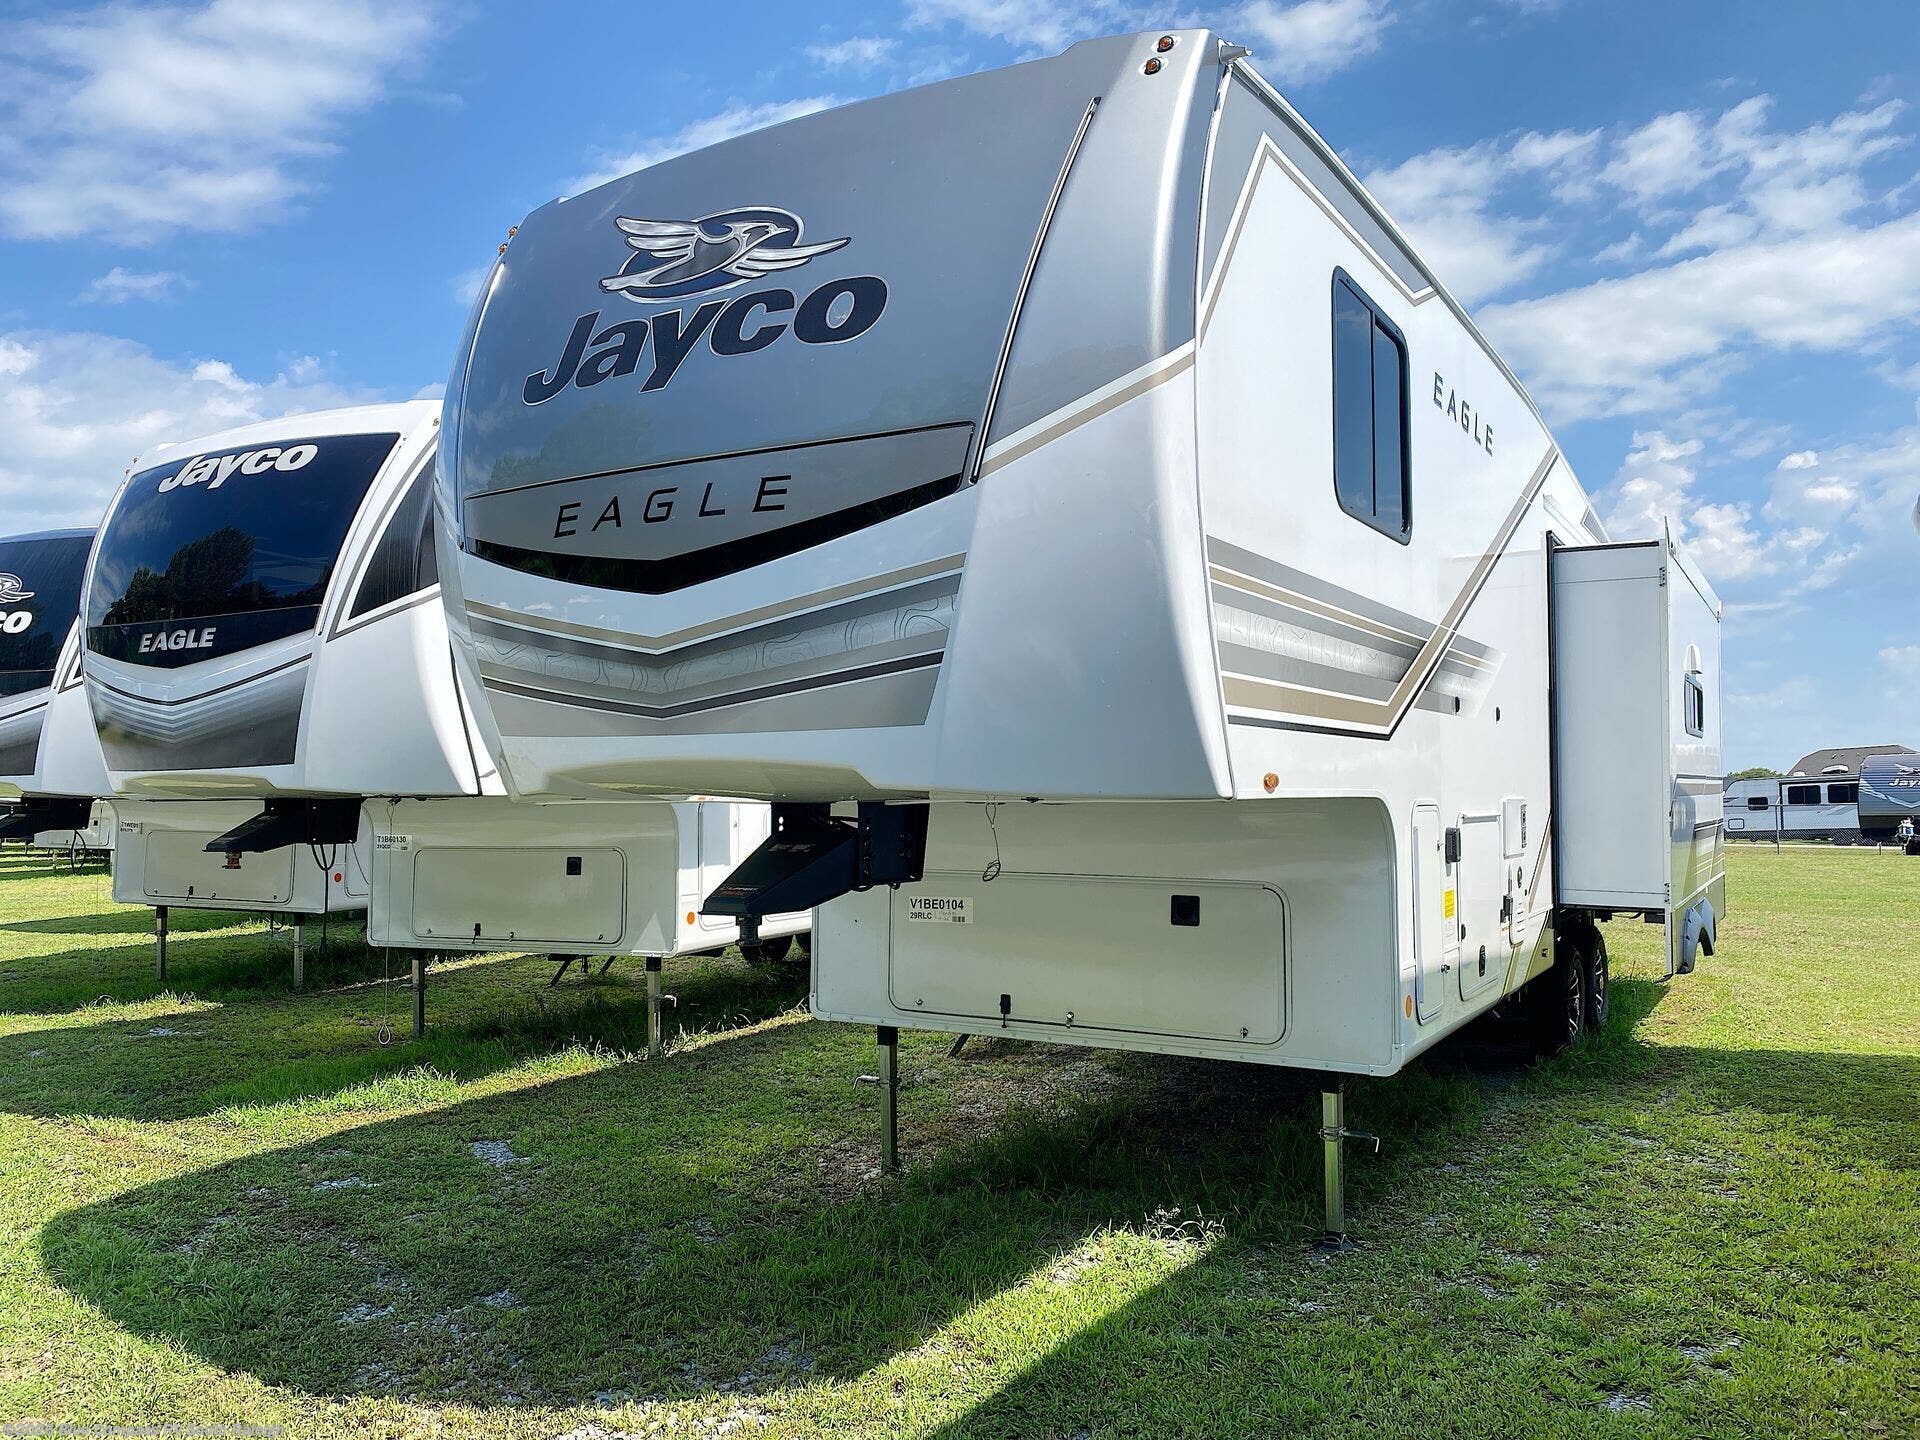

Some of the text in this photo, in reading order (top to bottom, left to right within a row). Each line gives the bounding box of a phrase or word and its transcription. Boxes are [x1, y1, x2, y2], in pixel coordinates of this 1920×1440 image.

[522, 275, 889, 406] Jayco
[1433, 371, 1494, 456] EAGLE
[157, 444, 318, 493] Jayco
[553, 475, 792, 538] EAGLE
[138, 627, 216, 653] EAGLE
[910, 898, 964, 910] V1BE0104
[910, 911, 932, 920] 29RLC
